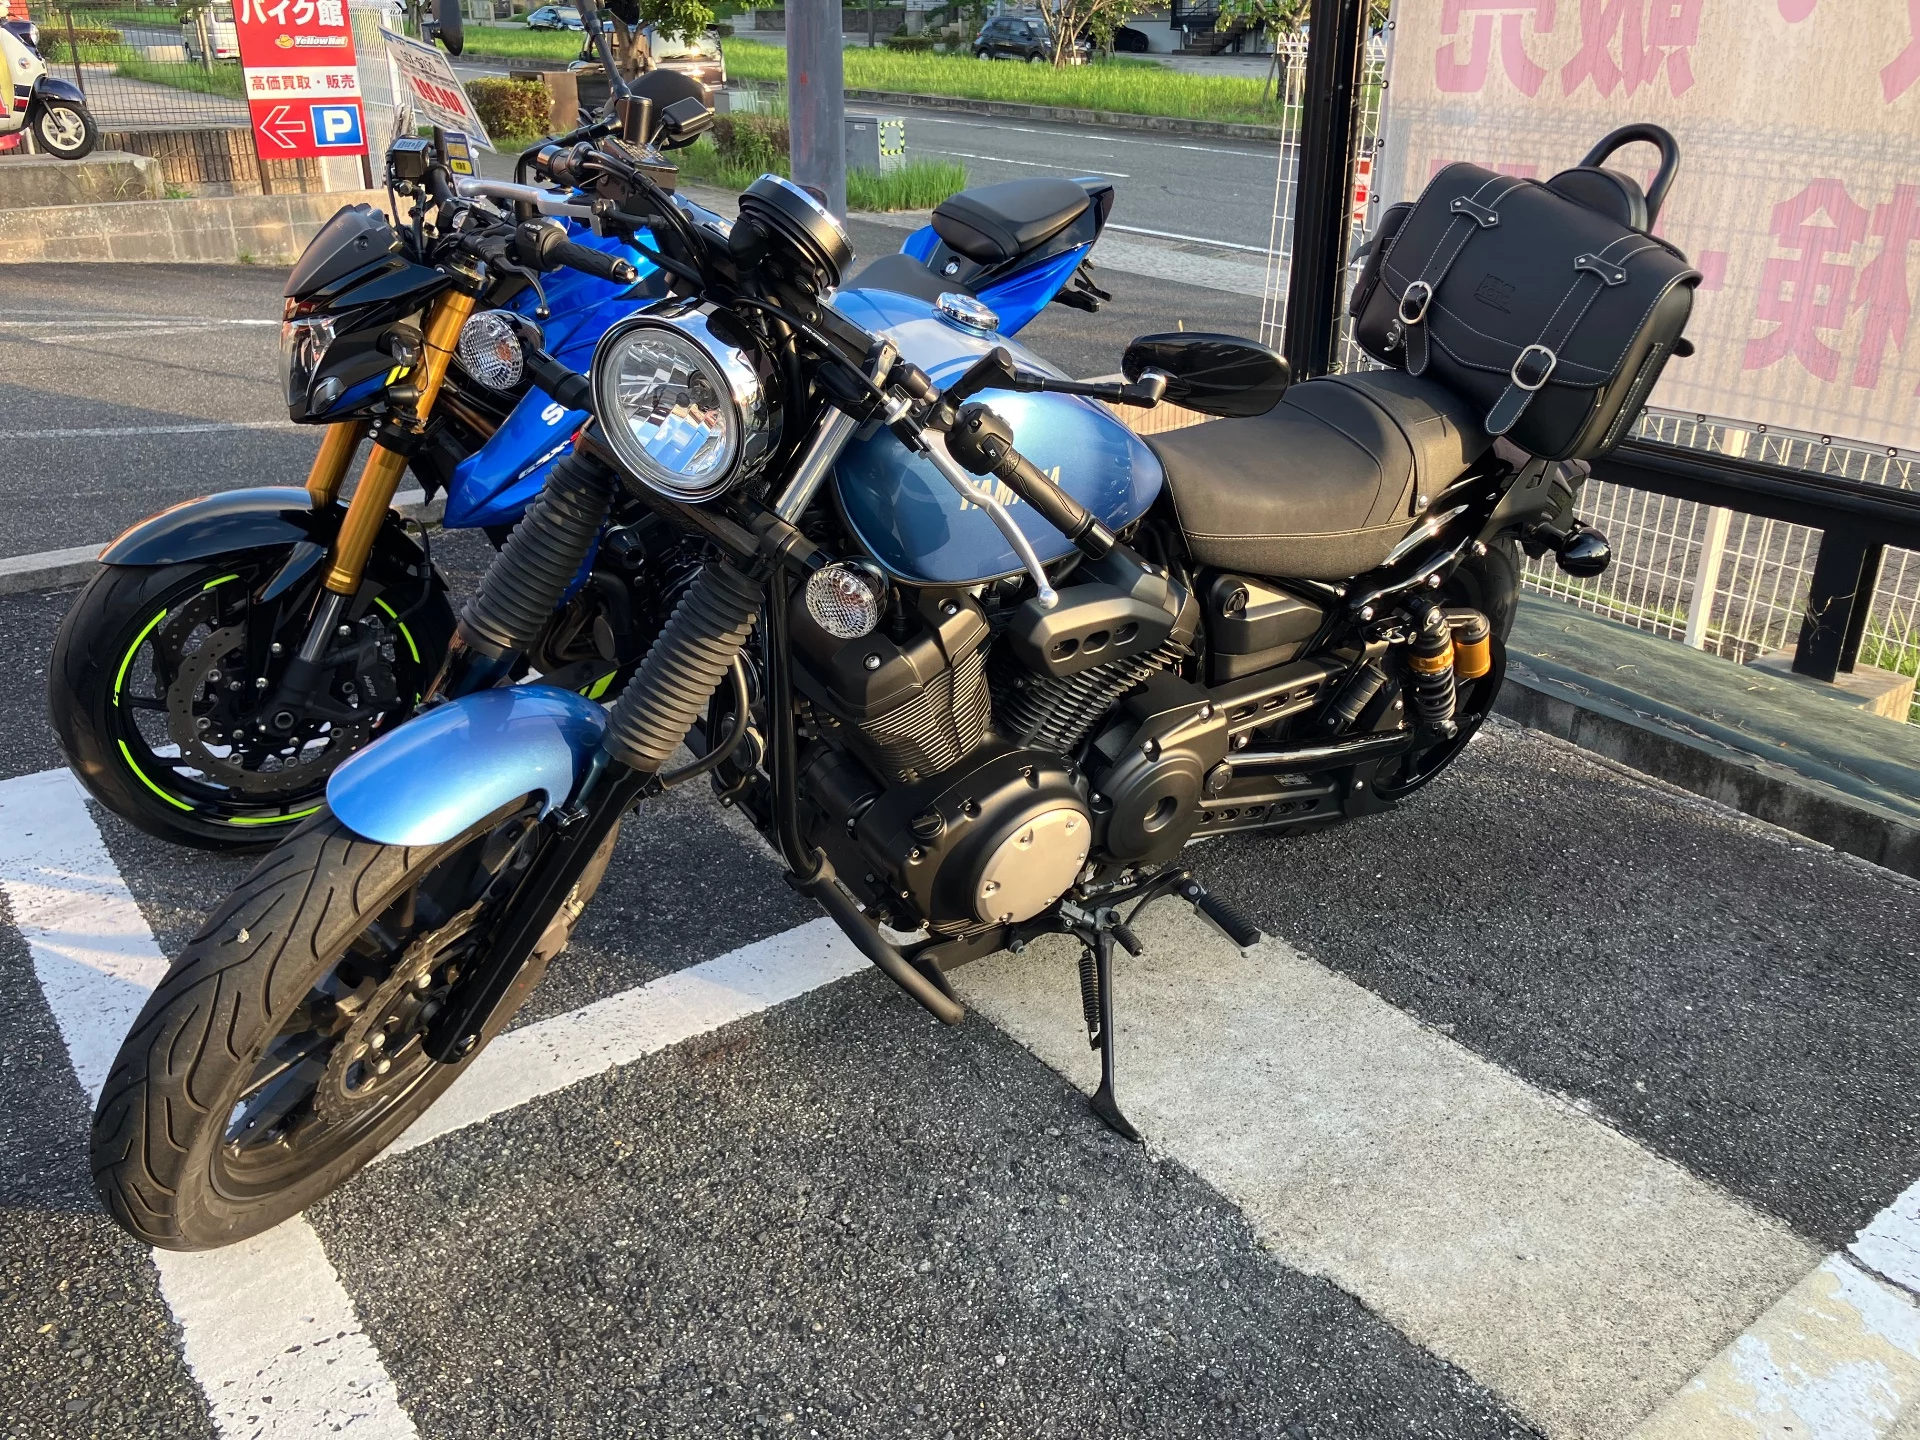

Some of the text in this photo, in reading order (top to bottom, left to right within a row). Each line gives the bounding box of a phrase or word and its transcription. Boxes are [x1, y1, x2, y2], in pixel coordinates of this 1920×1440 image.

[250, 74, 355, 91] 高価買取・販売
[325, 110, 352, 142] P
[960, 466, 1061, 511] YAM
